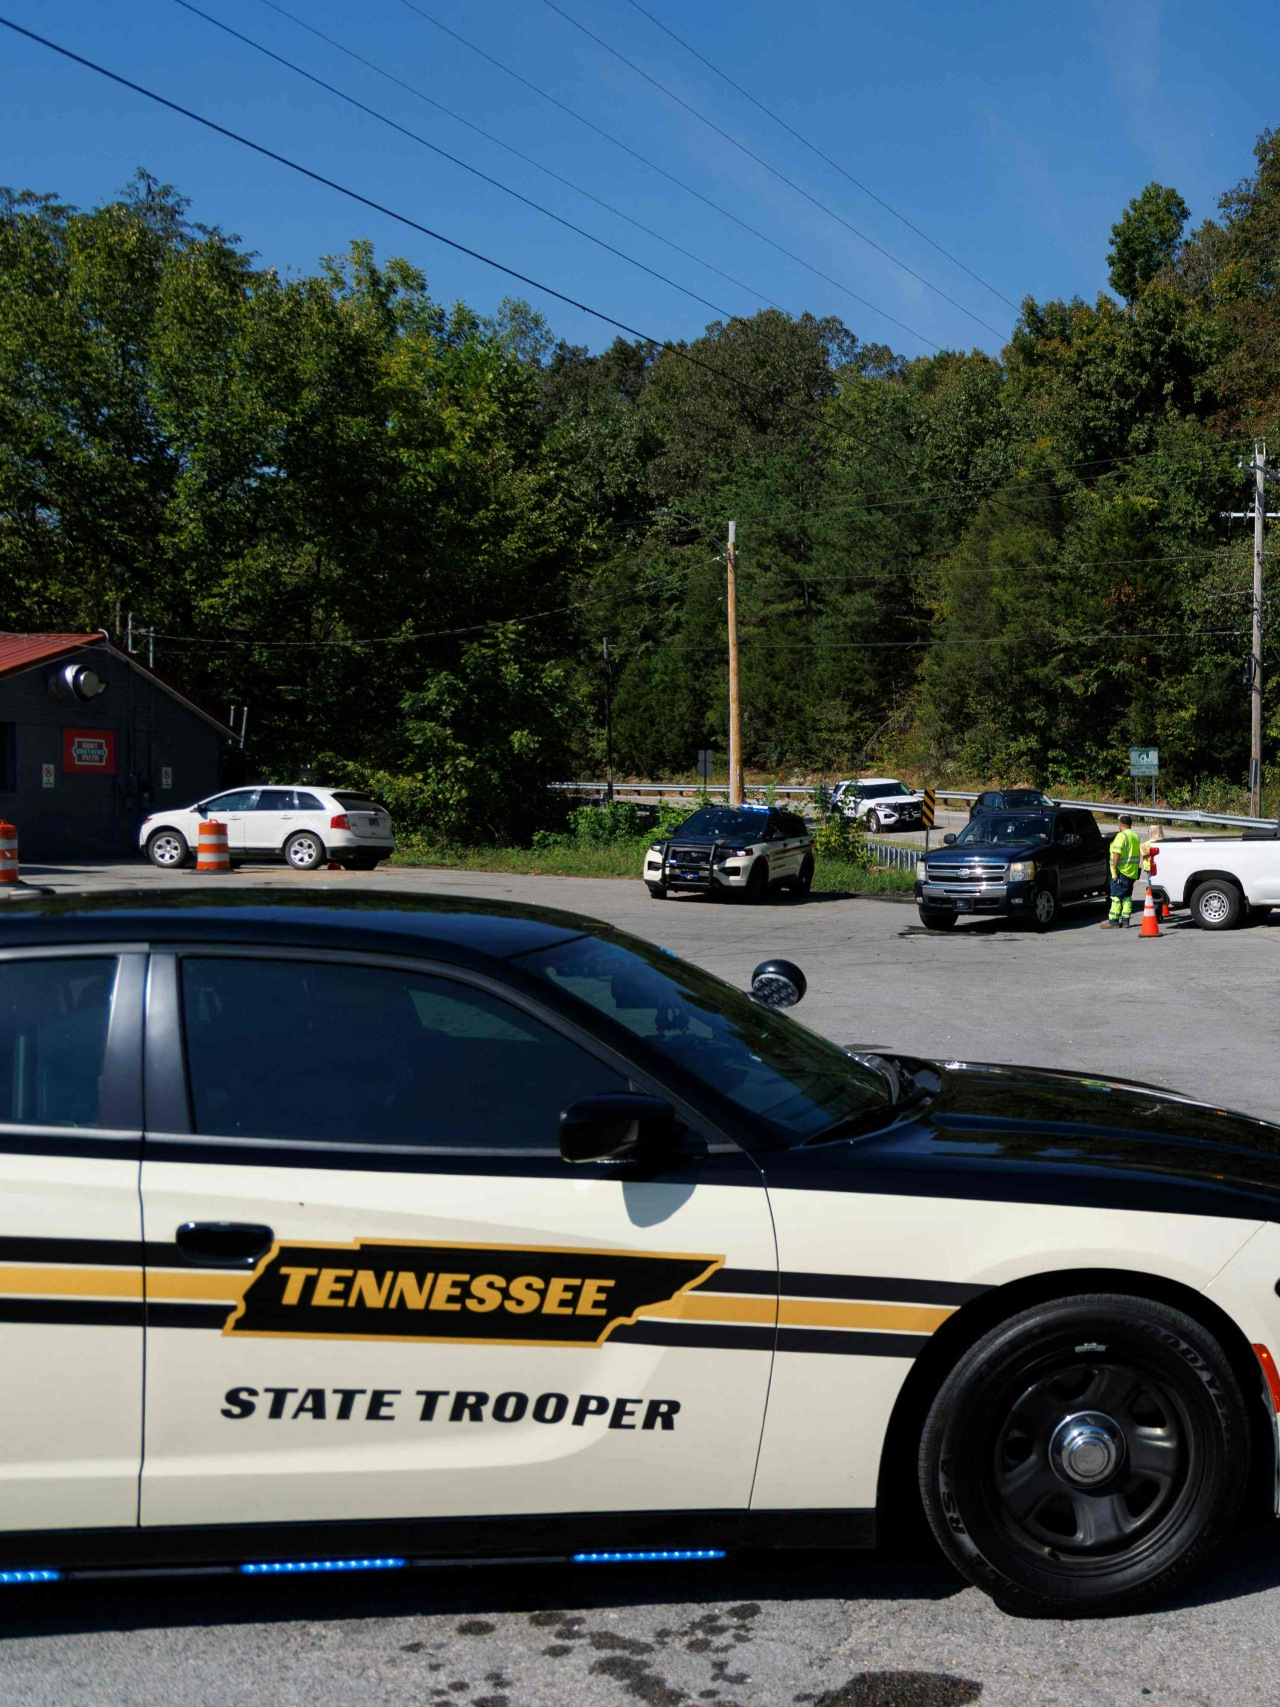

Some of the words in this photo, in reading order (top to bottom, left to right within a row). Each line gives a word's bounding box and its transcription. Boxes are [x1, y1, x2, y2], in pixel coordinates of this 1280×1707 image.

[278, 1266, 616, 1316] TENNESSEE
[220, 1386, 402, 1421] STATE
[415, 1389, 682, 1431] TROOPER
